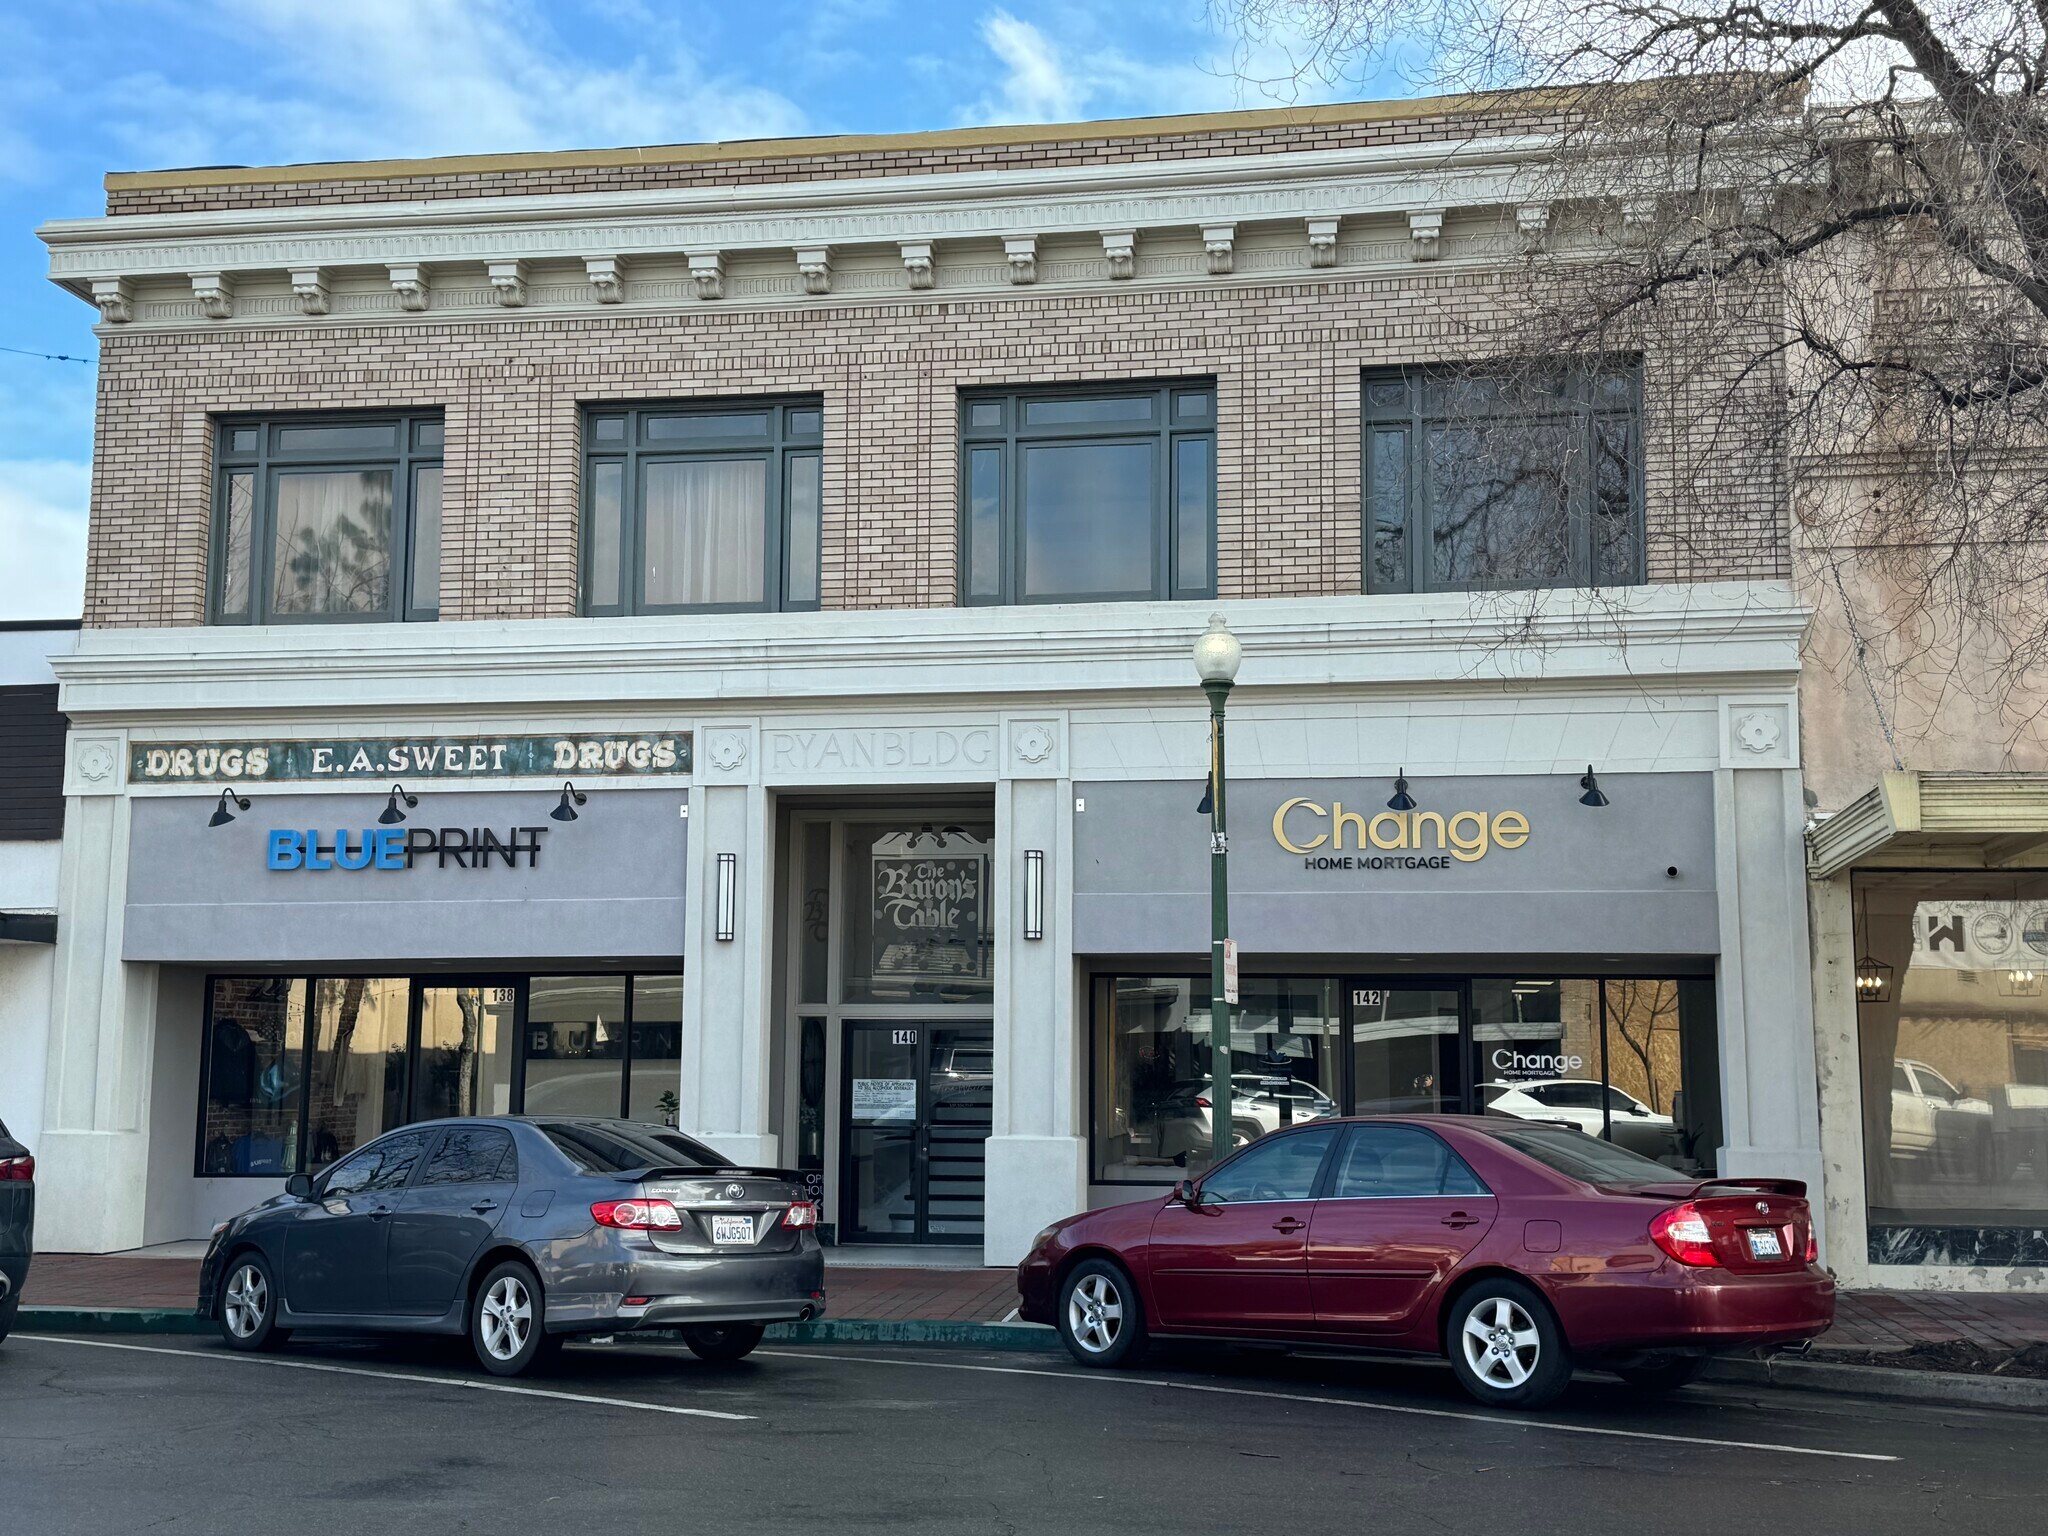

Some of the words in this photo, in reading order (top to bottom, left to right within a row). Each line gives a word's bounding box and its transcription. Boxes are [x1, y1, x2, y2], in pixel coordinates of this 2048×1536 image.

[145, 747, 269, 777] DRUGS
[553, 740, 676, 770] DRUGS
[1272, 797, 1530, 862] Change
[267, 826, 548, 870] BLUEPRINT
[1304, 857, 1352, 870] HOME
[1357, 856, 1450, 869] MORTGAGE
[878, 868, 977, 903] Baron's
[884, 898, 961, 930] Table
[492, 988, 514, 1002] 138
[1355, 991, 1379, 1005] 142
[894, 1030, 916, 1044] 140
[1492, 1048, 1582, 1073] Change
[806, 1173, 824, 1184] OP
[716, 1226, 751, 1240] 6WJG507
